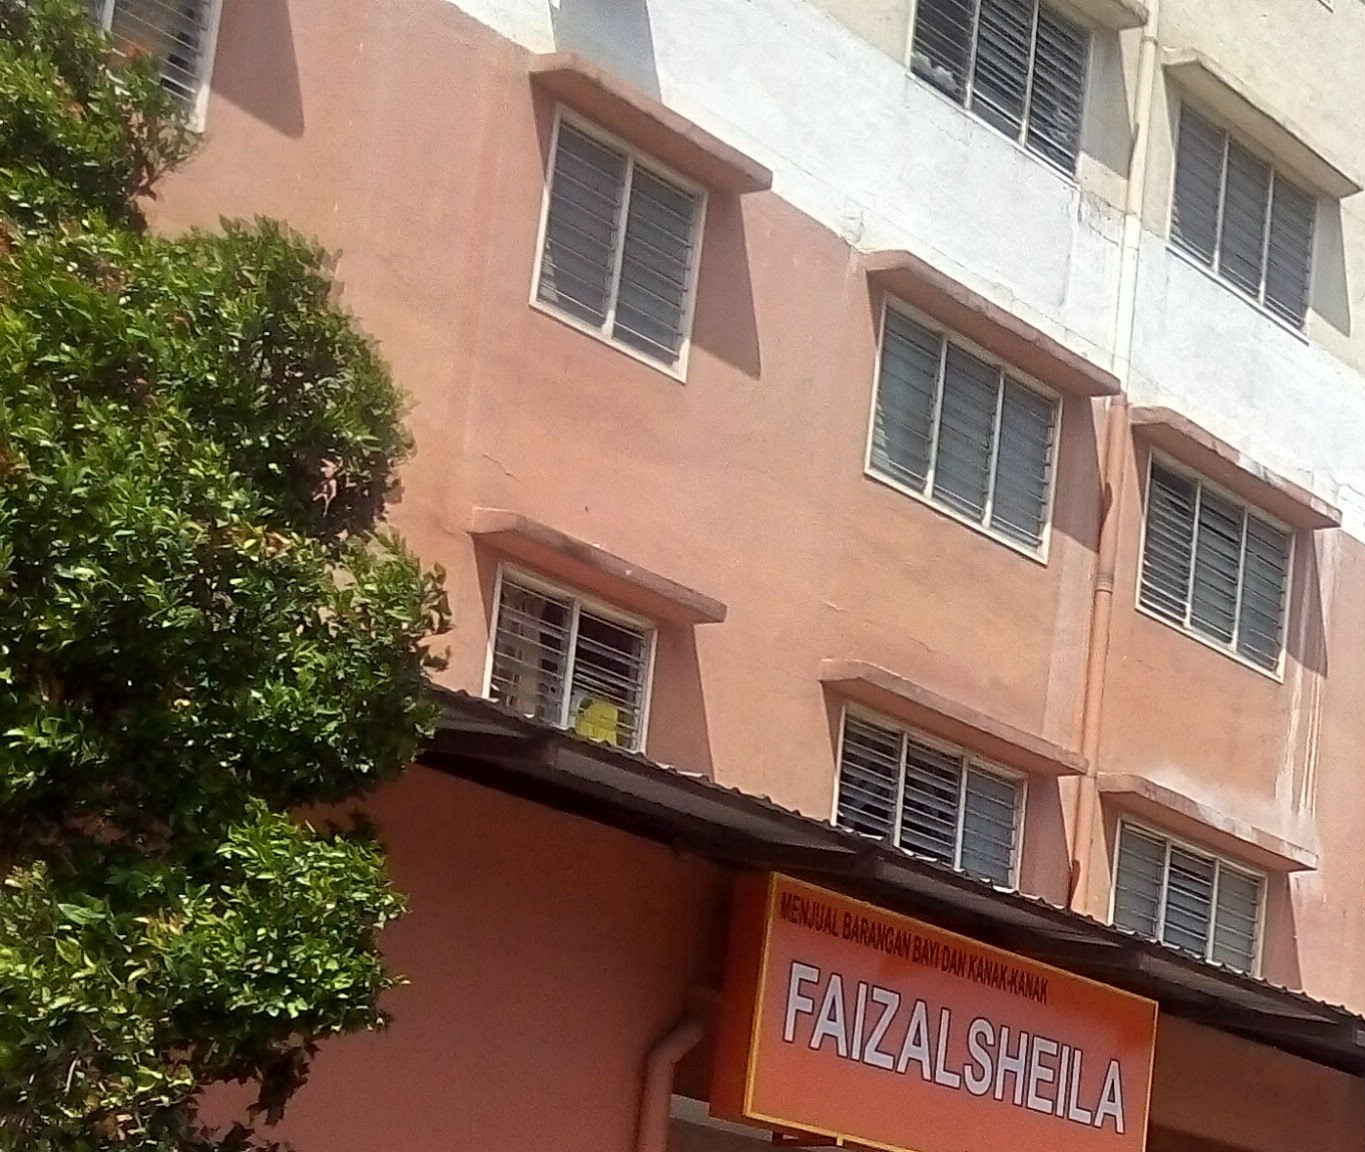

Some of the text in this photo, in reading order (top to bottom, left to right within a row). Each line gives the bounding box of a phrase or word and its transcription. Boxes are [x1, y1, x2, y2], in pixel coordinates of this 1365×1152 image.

[781, 892, 1049, 1005] MENJUAL BARANGAN BAYI DAN KANAK-KANAK
